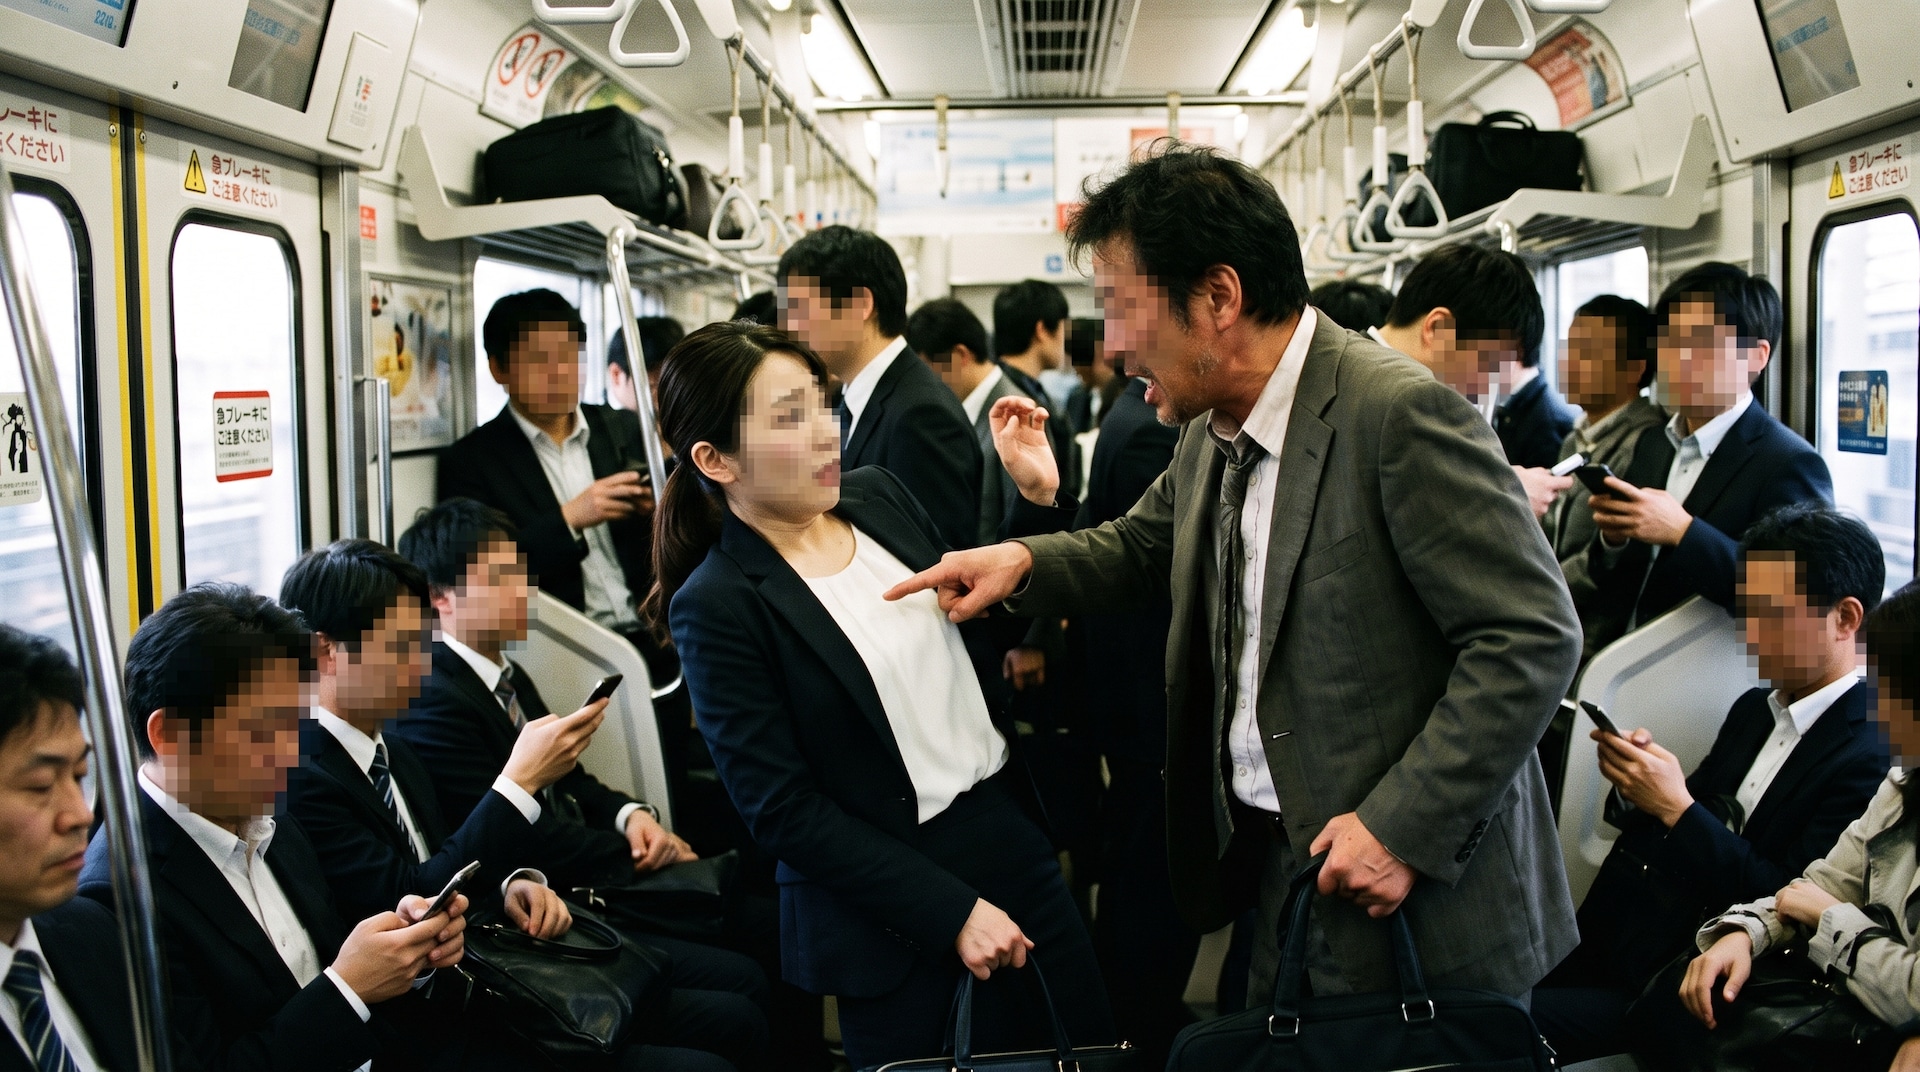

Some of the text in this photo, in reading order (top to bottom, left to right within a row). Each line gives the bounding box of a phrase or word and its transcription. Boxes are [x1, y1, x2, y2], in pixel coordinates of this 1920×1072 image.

[0, 132, 64, 163] ください
[213, 179, 278, 208] ご注意ください
[218, 429, 269, 446] ご注意ください
